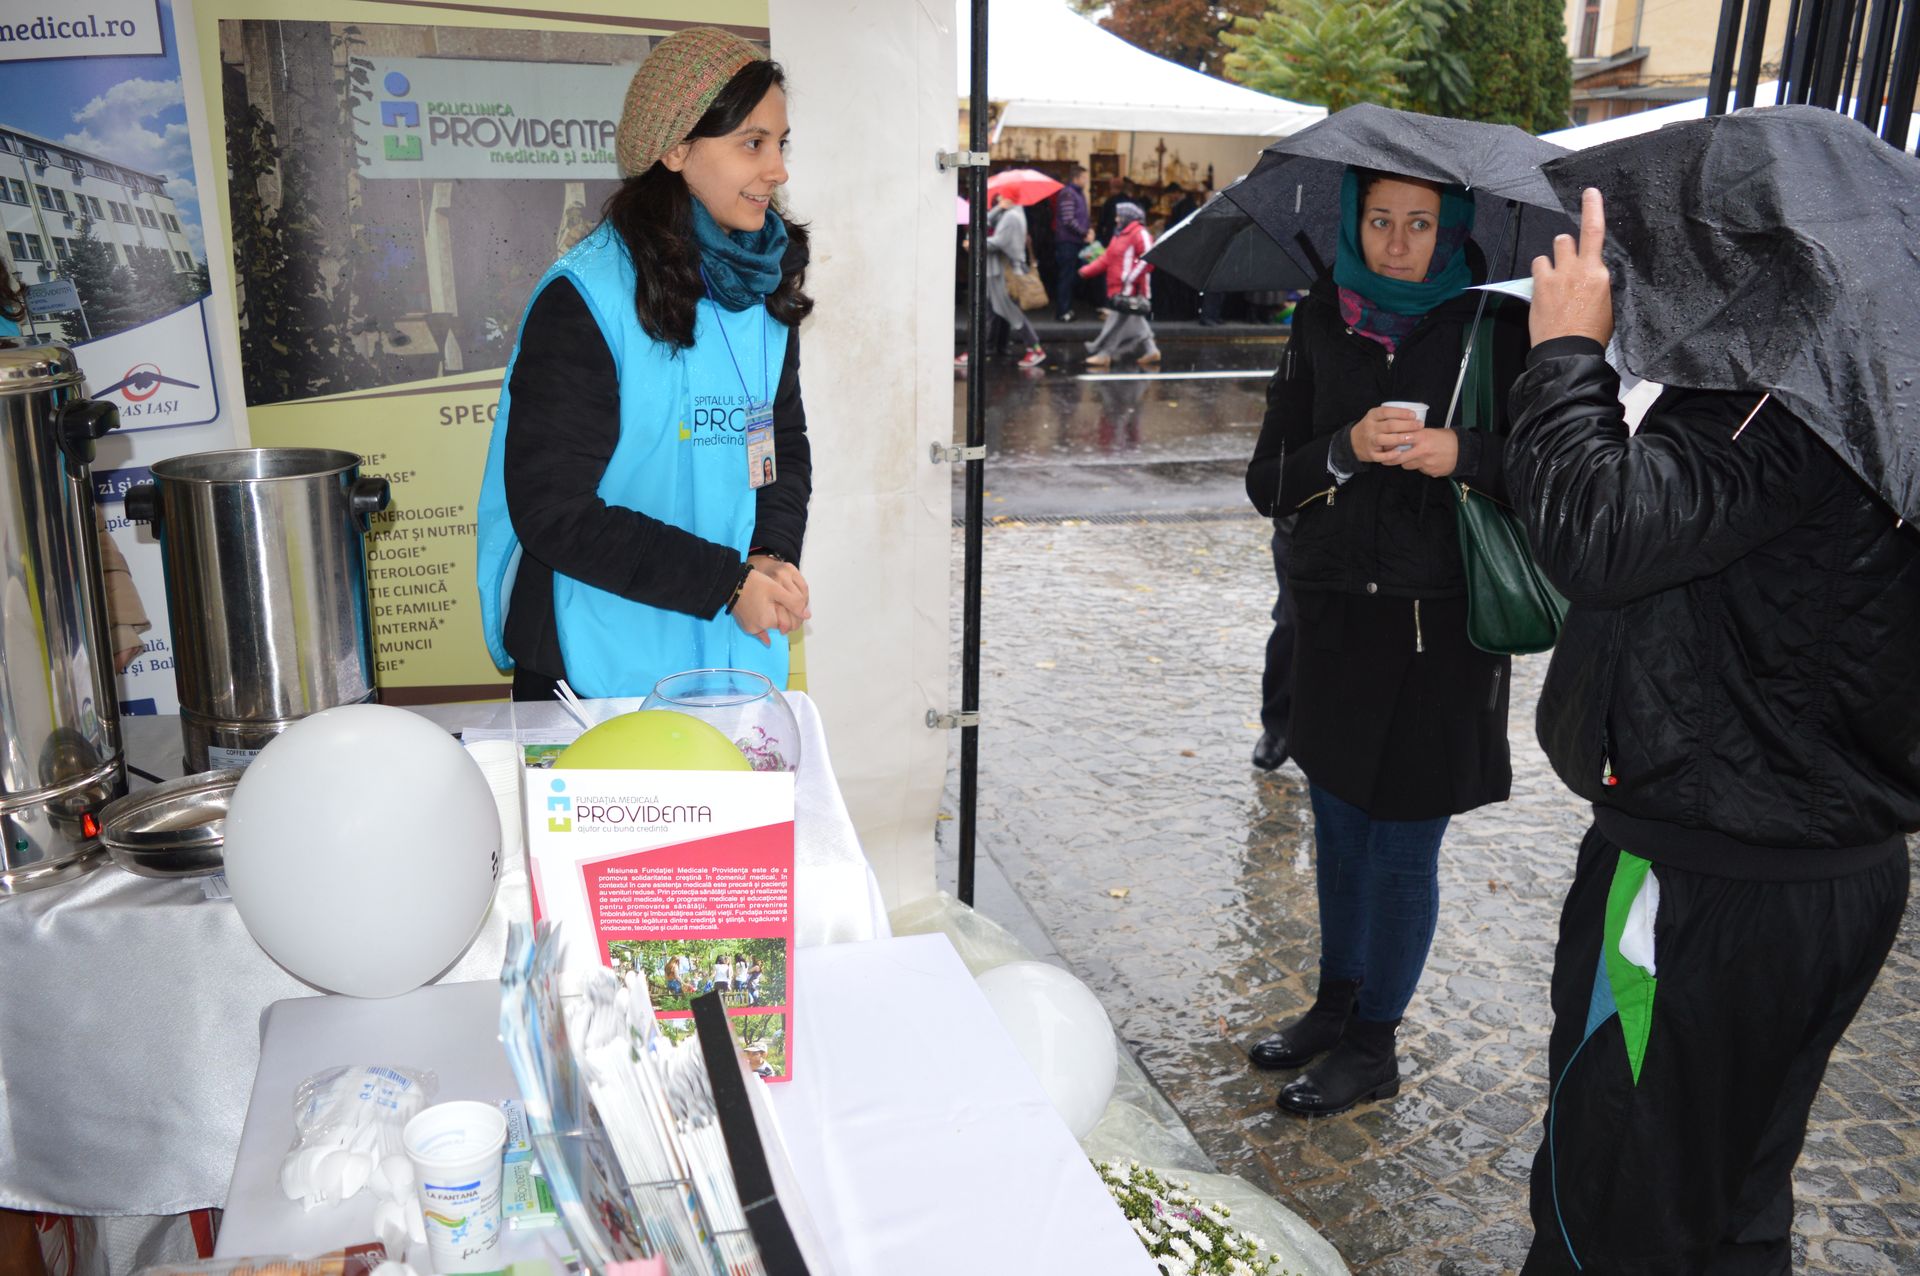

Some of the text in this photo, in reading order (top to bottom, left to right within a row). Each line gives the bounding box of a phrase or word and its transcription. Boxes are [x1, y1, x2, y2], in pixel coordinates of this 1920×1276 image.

[427, 102, 514, 117] POLICLINICA
[694, 395, 736, 406] SPITALUL
[440, 403, 498, 426] SPEC
[694, 408, 746, 432] PRO
[694, 434, 744, 446] medicină
[98, 480, 115, 495] zi
[393, 580, 448, 597] CLINICĂ
[375, 604, 392, 617] DE
[380, 638, 432, 654] MUNCII
[577, 806, 712, 824] PROVIDENTA
[578, 826, 600, 834] ajutor
